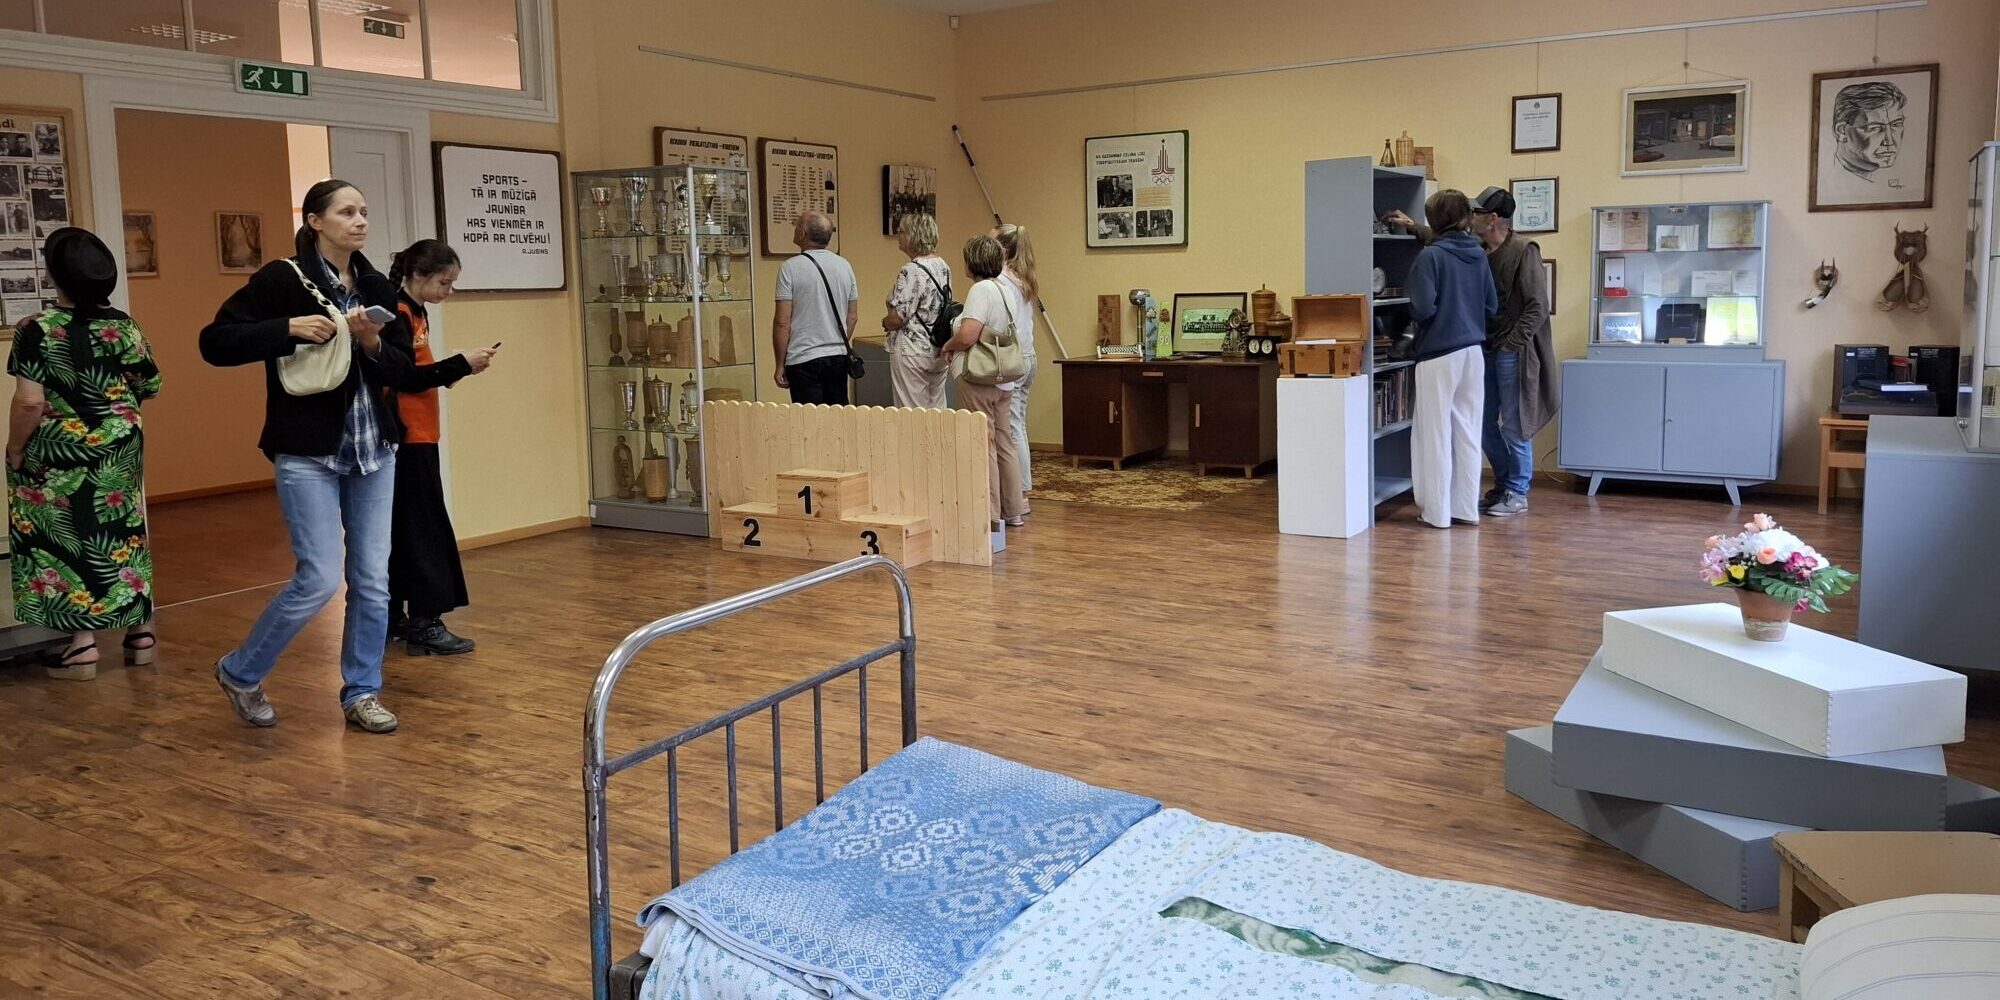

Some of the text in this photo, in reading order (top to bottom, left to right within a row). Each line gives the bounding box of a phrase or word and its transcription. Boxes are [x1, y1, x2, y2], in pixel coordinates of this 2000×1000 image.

[0, 119, 15, 129] di
[482, 174, 519, 186] SPORTS
[471, 187, 537, 201] TĀ IR MŪZĪGĀ
[467, 218, 545, 230] KAS VIENMĒR IR
[493, 233, 506, 243] AR
[797, 485, 812, 515] 1
[743, 518, 761, 547] 2
[860, 530, 880, 555] 3
